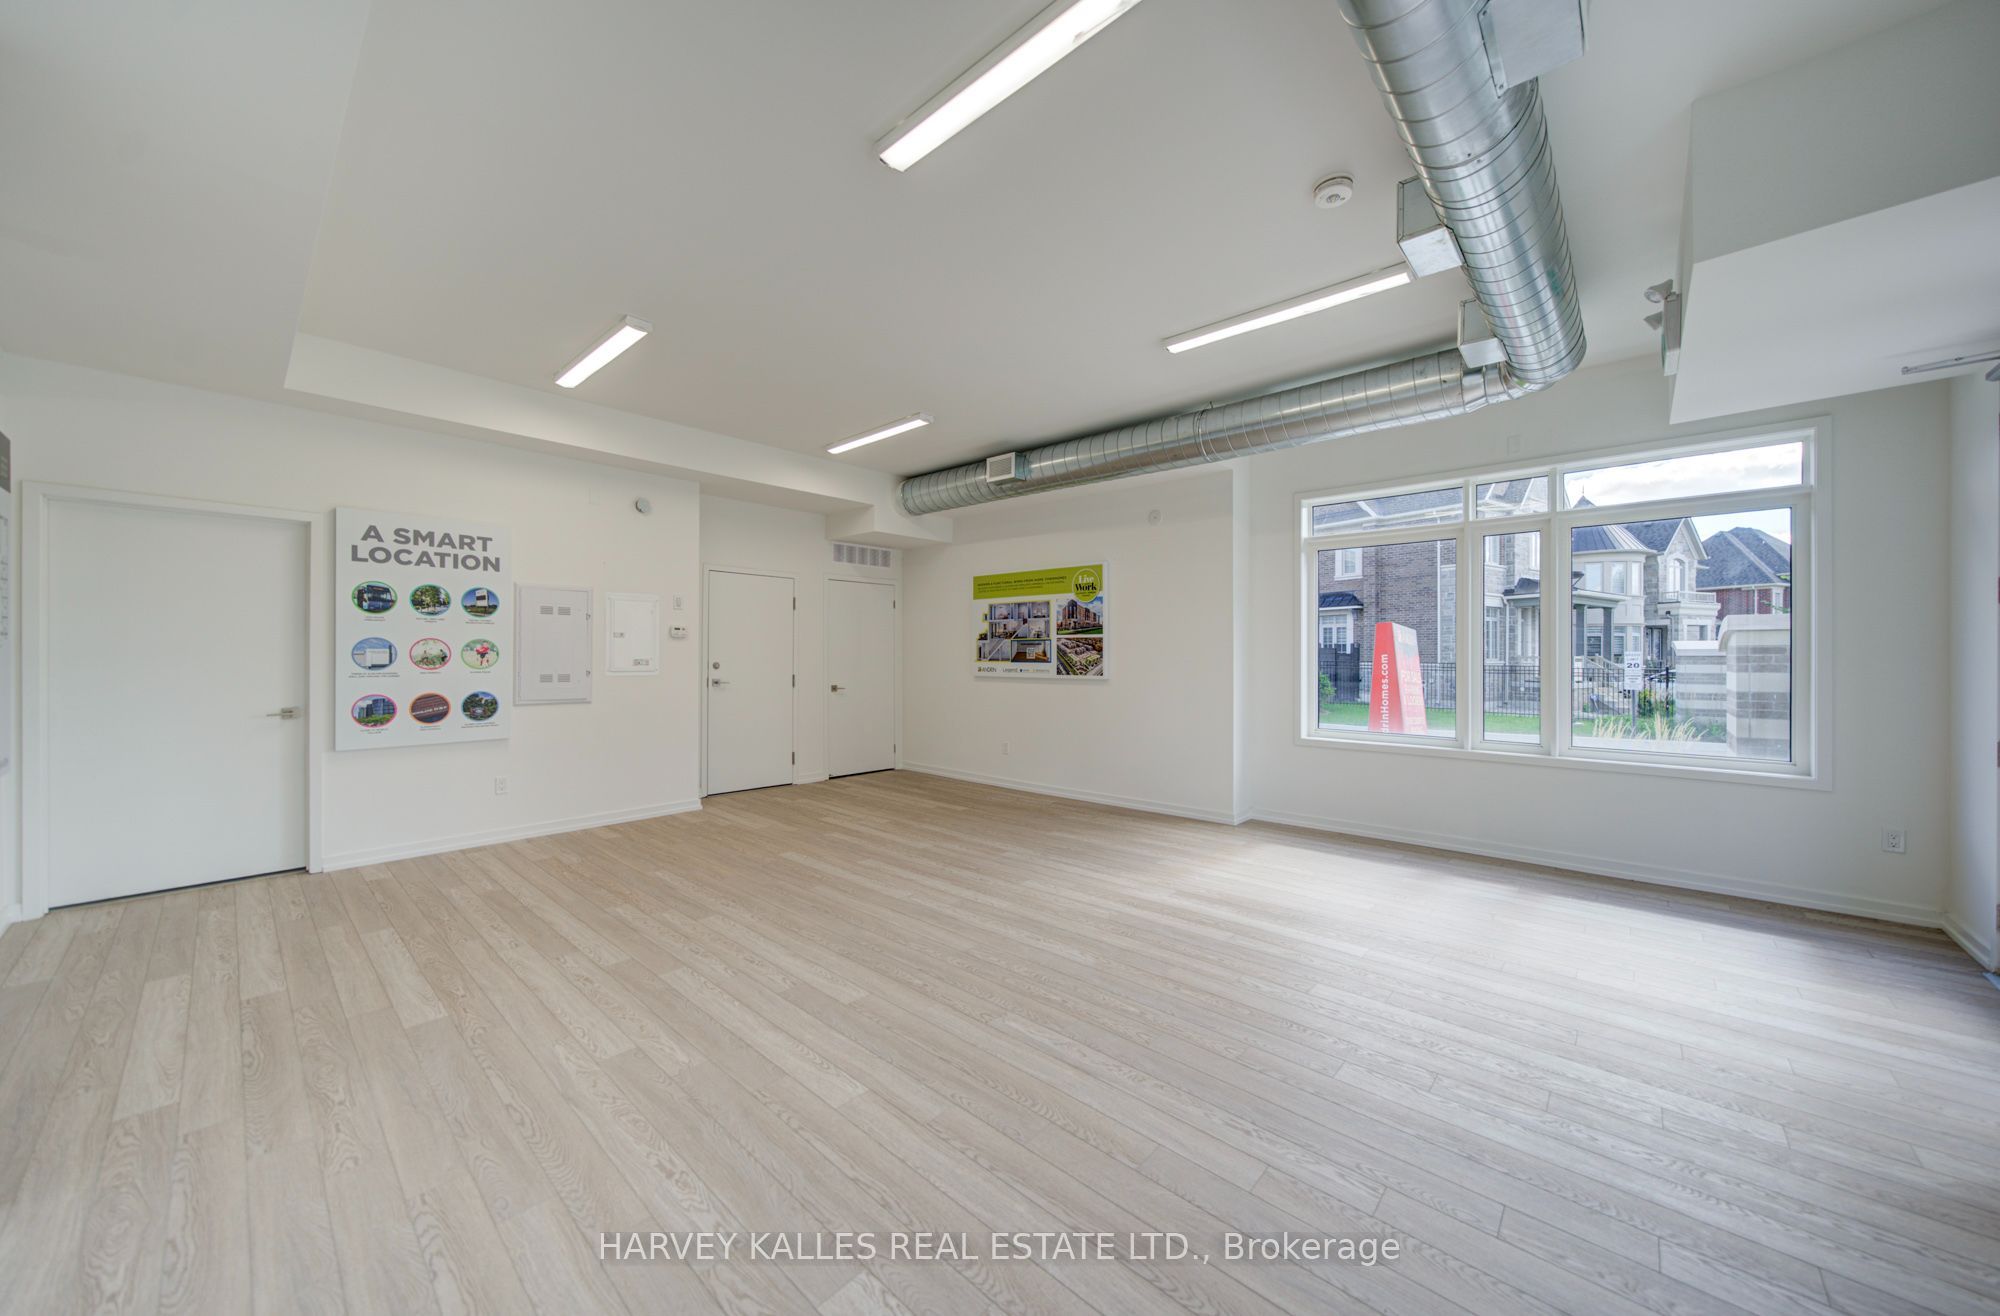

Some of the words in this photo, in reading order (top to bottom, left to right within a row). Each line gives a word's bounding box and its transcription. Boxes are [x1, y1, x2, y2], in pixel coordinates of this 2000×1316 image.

[360, 525, 384, 542] A
[393, 527, 493, 552] SMART
[351, 545, 500, 572] LOCATION
[1075, 582, 1097, 591] Work
[1078, 574, 1094, 583] Live
